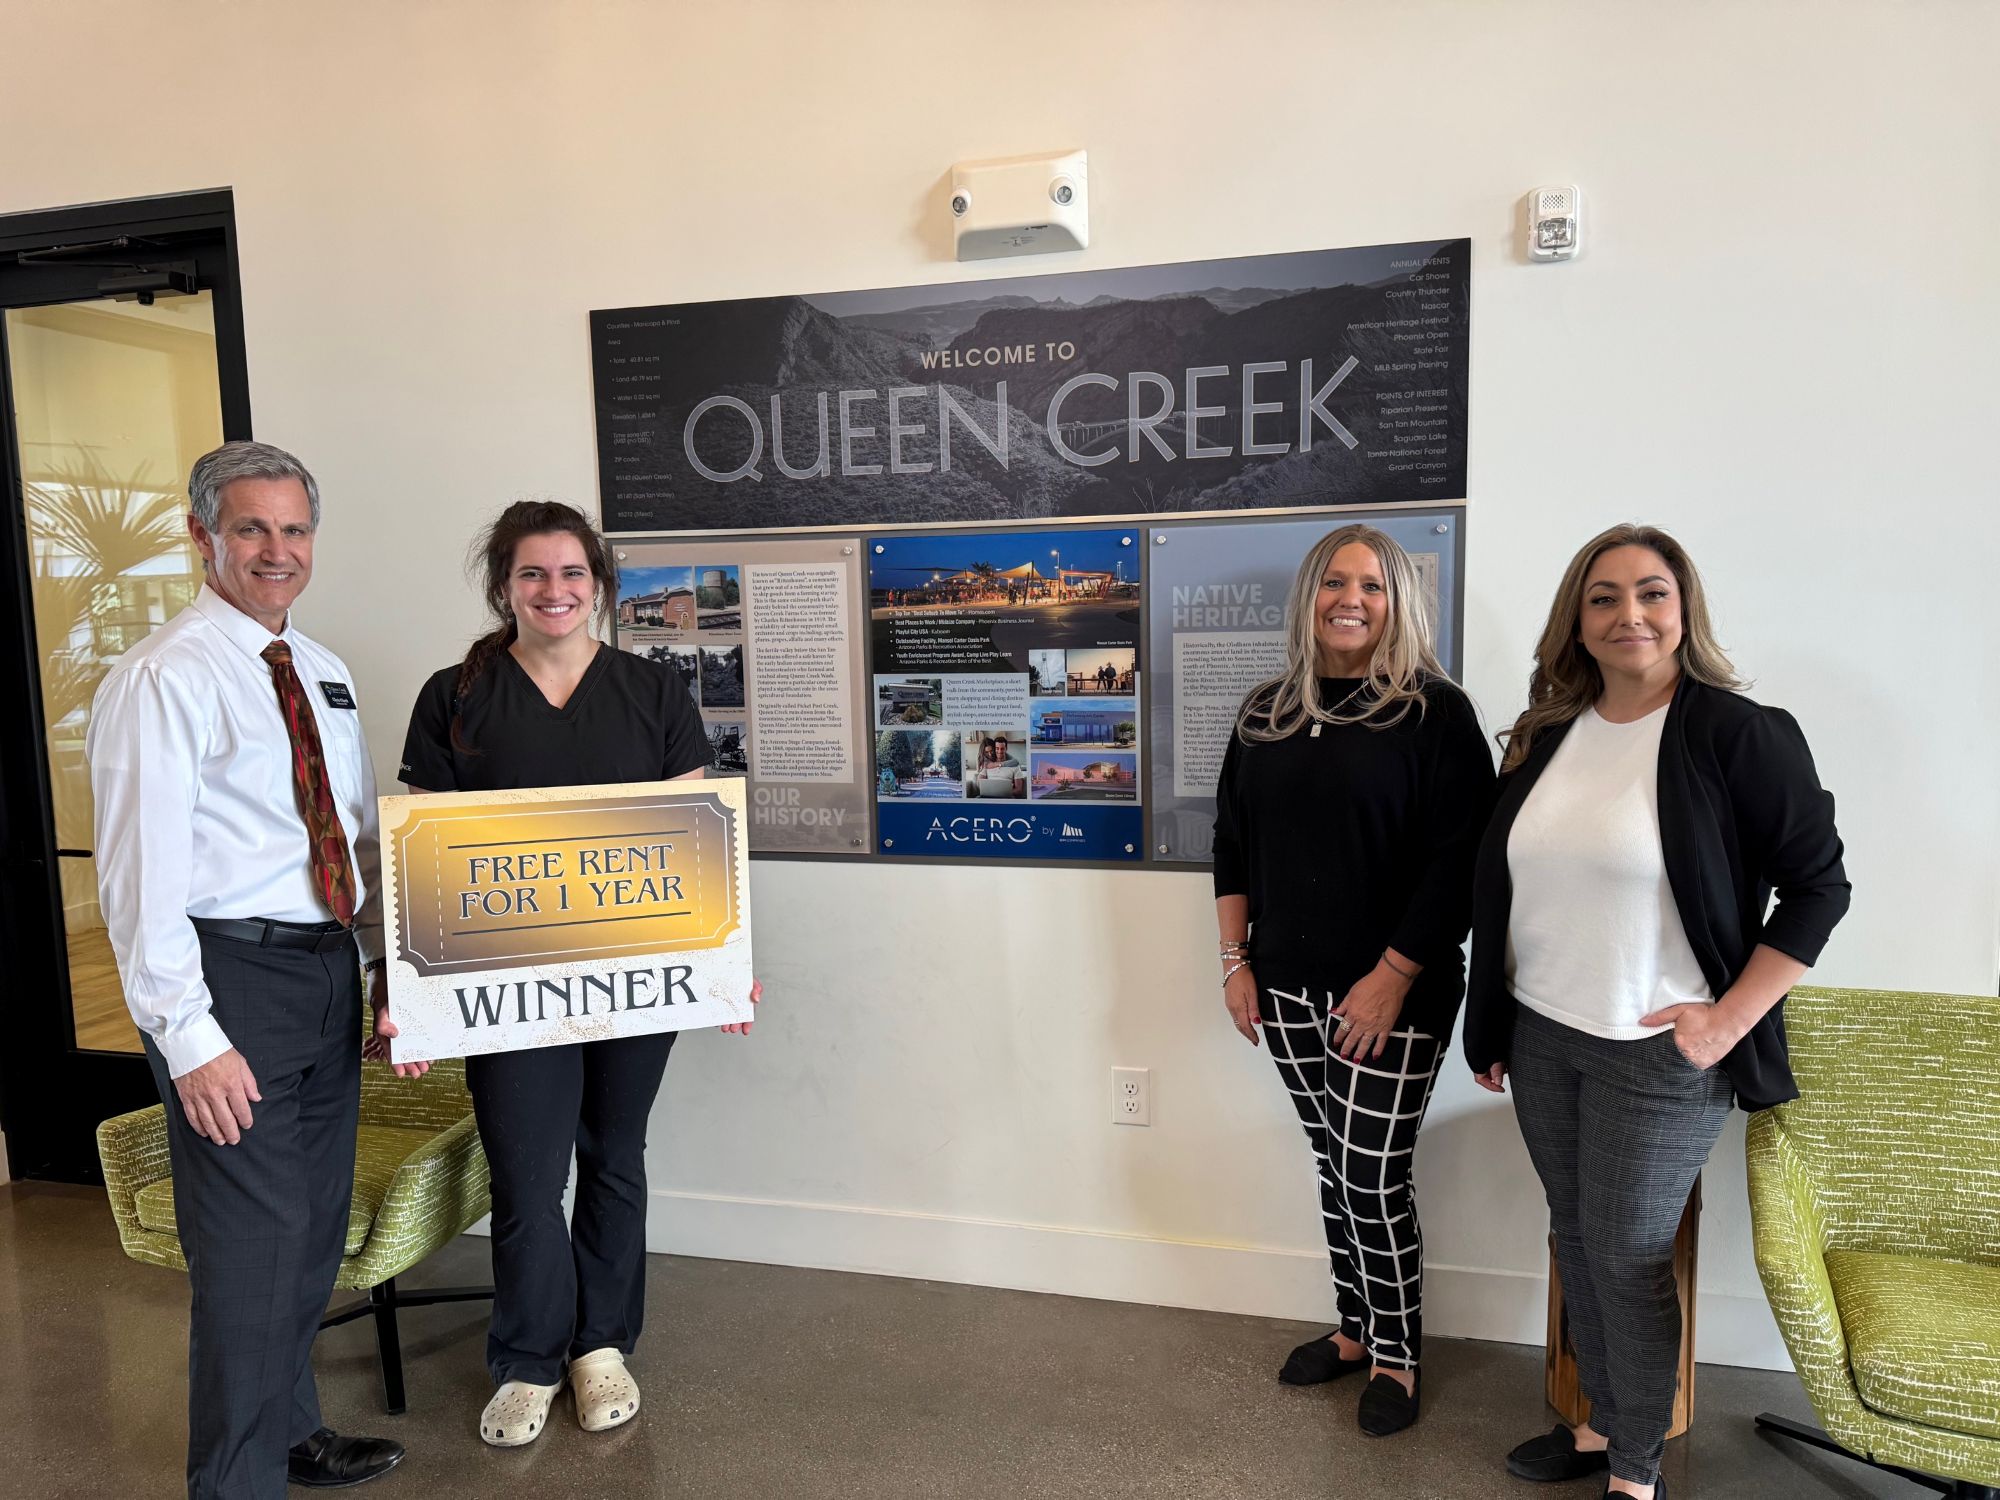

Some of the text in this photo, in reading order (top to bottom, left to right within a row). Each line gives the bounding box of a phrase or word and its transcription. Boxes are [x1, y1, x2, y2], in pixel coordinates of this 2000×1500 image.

[1390, 257, 1450, 268] ANNUAL EVENTS
[1426, 272, 1450, 280] Shows
[1386, 287, 1449, 298] Country Thunder
[1421, 302, 1450, 310] Nascar
[1347, 316, 1449, 330] American Heritage Festival
[1393, 331, 1449, 341] Phoenix Open
[1413, 345, 1448, 354] State Fair
[921, 341, 1075, 370] WELCOME TO
[1392, 362, 1416, 372] Spring
[1418, 360, 1448, 369] Training
[1376, 392, 1402, 400] POINTS
[1416, 389, 1448, 398] INTEREST
[1381, 404, 1448, 415] Riparian Preserve
[684, 355, 1360, 483] QUEEN CREEK
[1378, 418, 1448, 429] San Tan Mountain
[1393, 434, 1427, 443] Saguaro
[1389, 448, 1423, 457] National
[1424, 447, 1447, 455] Forest
[1389, 462, 1446, 471] Grand Canyon
[1420, 475, 1446, 484] Tucson
[1173, 584, 1262, 606] NATIVE
[1173, 605, 1282, 628] HERITAG
[754, 787, 800, 806] OUR
[755, 808, 846, 826] HISTORY
[1042, 826, 1054, 837] by
[468, 843, 675, 885] FREE RENT
[458, 875, 685, 919] FOR 1 YEAR
[454, 965, 700, 1029] WINNER
